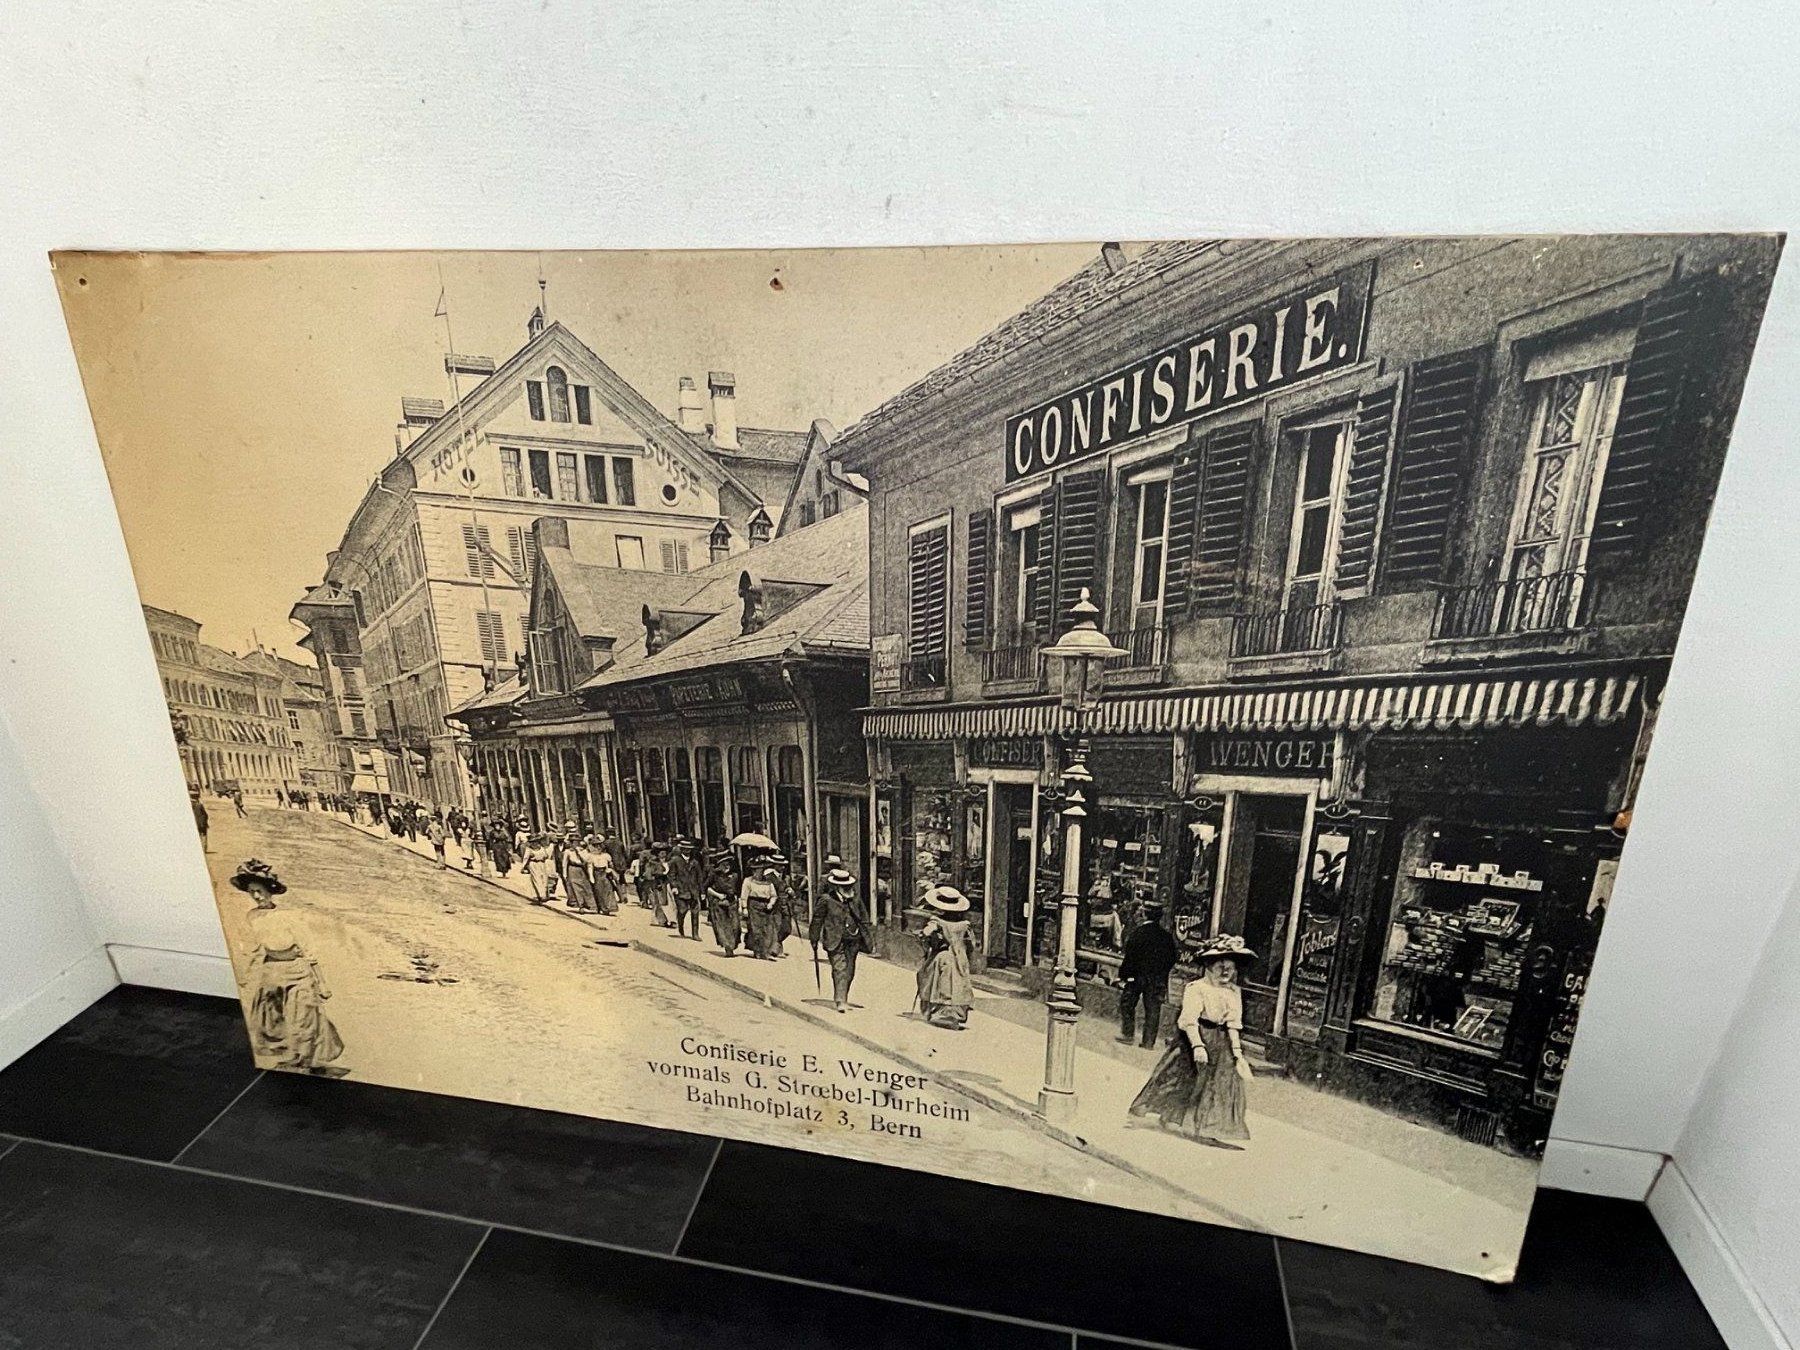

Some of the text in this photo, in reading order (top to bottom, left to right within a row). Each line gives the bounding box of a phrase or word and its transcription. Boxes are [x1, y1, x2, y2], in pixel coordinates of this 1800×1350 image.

[1013, 286, 1347, 475] CONFISERIE.
[647, 1061, 731, 1083] vormals
[745, 1071, 767, 1089] G.
[681, 1037, 929, 1091] Confiserie E. Wenger
[686, 1085, 922, 1139] Bahnhofplatz 3, Bern
